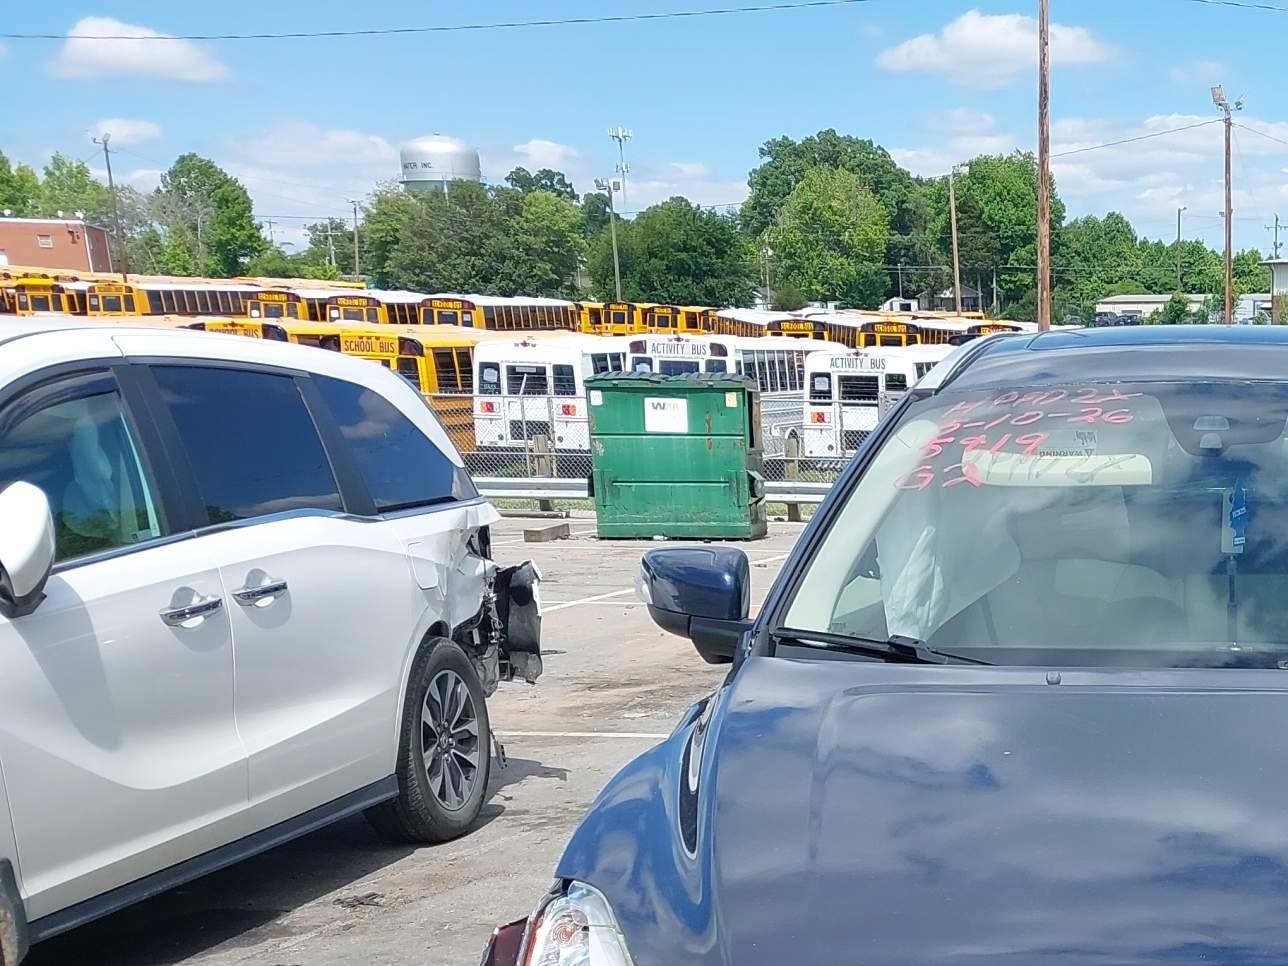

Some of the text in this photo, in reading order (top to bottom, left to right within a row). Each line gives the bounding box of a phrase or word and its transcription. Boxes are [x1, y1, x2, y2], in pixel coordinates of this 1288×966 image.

[344, 339, 395, 353] SCHOOL BUS
[651, 342, 707, 355] ACTIVITY BUS
[830, 357, 886, 369] ACTIVITY BUS
[1039, 449, 1083, 457] WARNING
